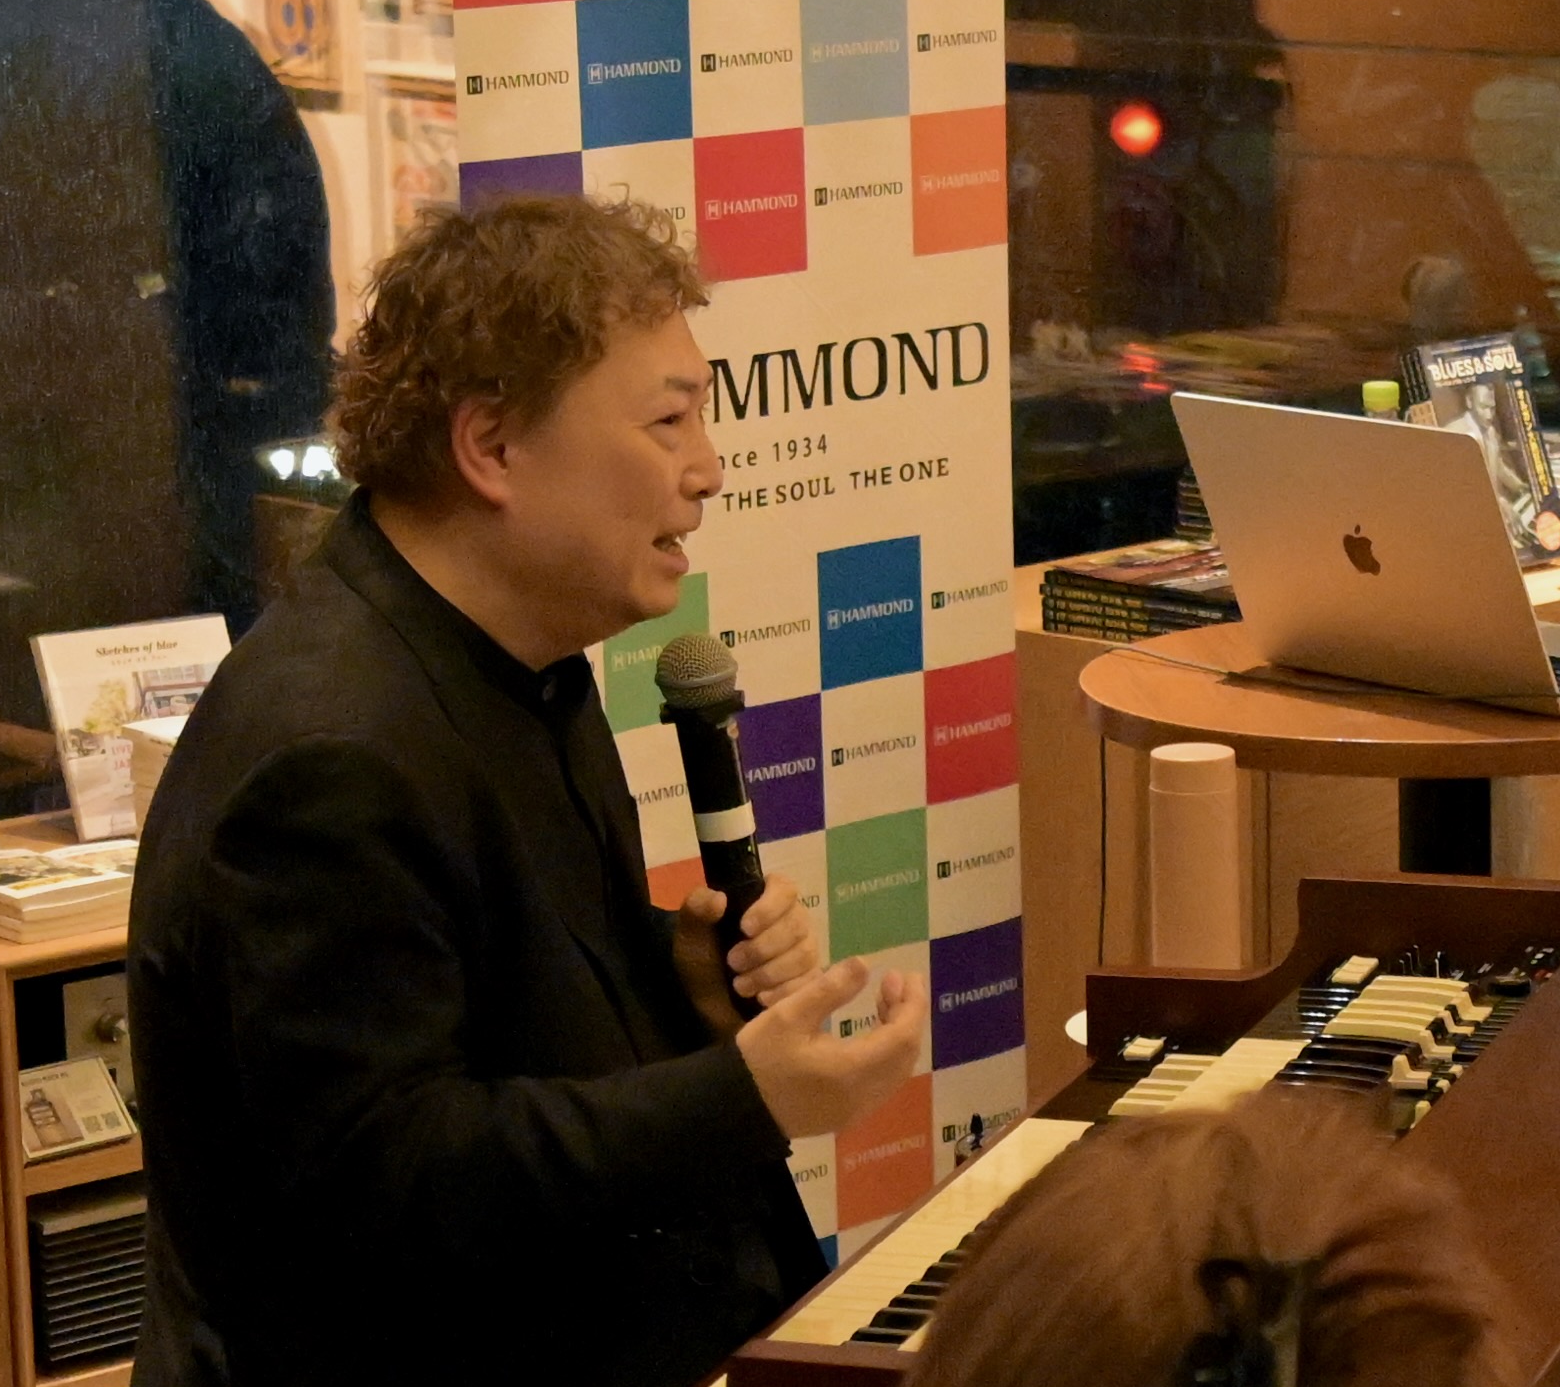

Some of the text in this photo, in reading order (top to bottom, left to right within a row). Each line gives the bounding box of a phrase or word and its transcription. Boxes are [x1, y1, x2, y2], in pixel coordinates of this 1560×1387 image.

[825, 38, 900, 59] HAMMOND
[932, 29, 997, 49] HAMMOND
[604, 58, 682, 80] HAMMOND
[718, 50, 793, 70] HAMMOND
[485, 70, 570, 92] HAMMOND
[937, 169, 1000, 191] HAMMOND
[723, 193, 798, 215] HAMMOND
[829, 181, 903, 205] HAMMOND
[708, 322, 989, 423] MMOND
[772, 433, 828, 463] 1934
[722, 457, 950, 512] THE SOUL THE ONE
[947, 580, 1009, 604] HAMMOND
[842, 598, 913, 624] HAMMOND
[737, 619, 811, 645] HAMMOND
[142, 642, 153, 654] of
[156, 640, 178, 651] blue
[950, 713, 1012, 741] HAMMOND
[846, 734, 917, 761] HAMMOND
[952, 846, 1015, 874] HAMMOND
[955, 977, 1019, 1007] HAMMOND
[857, 1134, 926, 1164] HAMMOND
